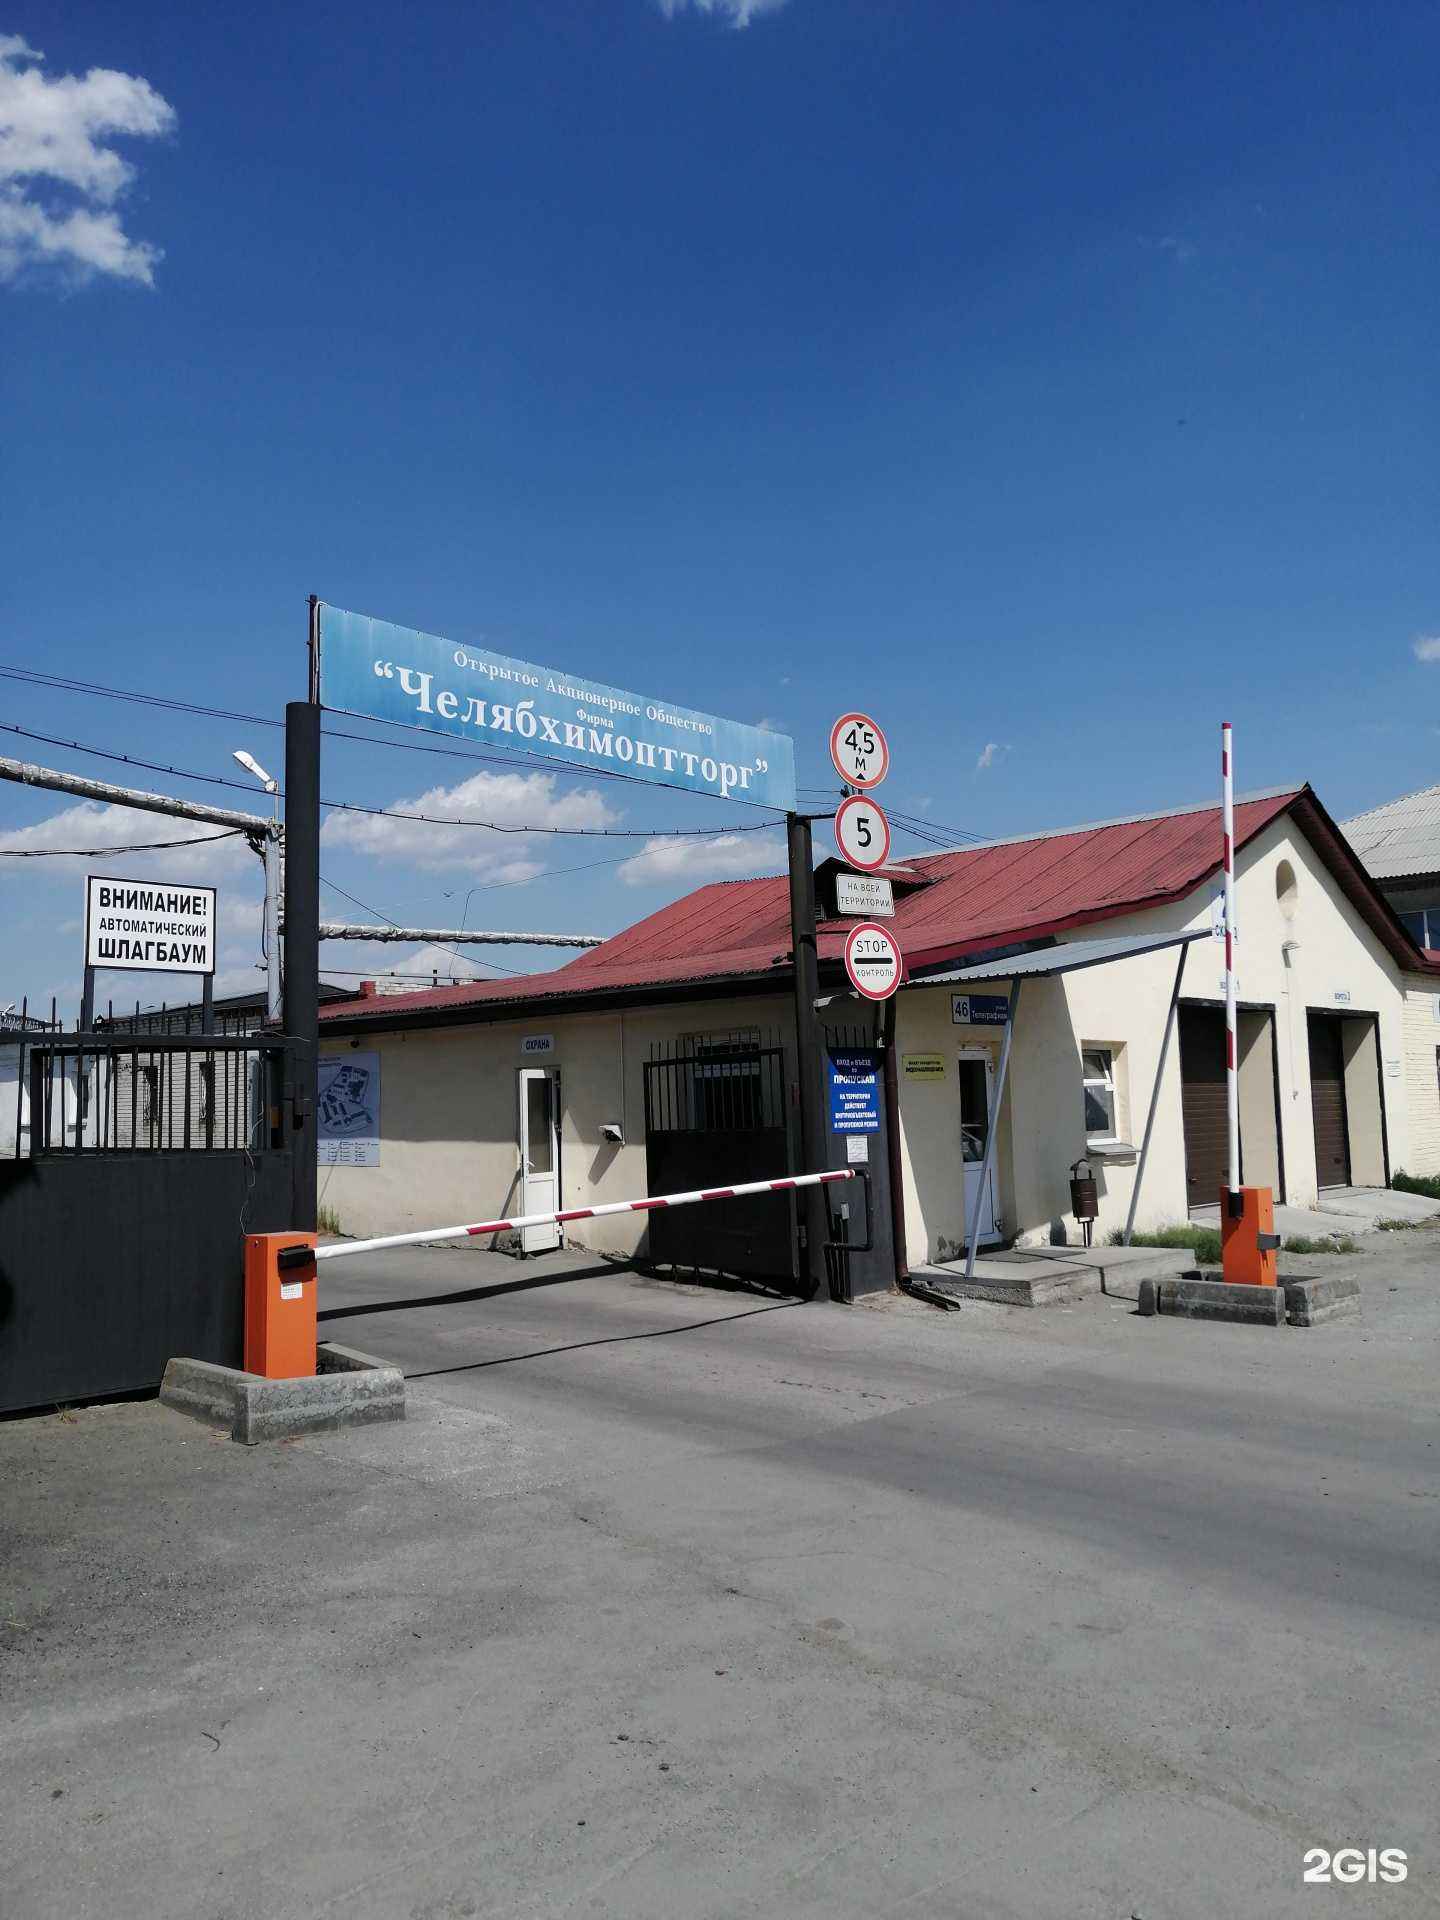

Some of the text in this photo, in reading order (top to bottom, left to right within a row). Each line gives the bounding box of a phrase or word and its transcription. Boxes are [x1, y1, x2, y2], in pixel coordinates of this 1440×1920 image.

[454, 650, 712, 736] Открытое Акционерное Общество
[576, 708, 615, 730] Фирма
[845, 729, 875, 755] 4,5
[857, 817, 872, 848] 5
[847, 882, 858, 892] НА
[99, 887, 207, 916] ВНИМАНИЕ!
[840, 896, 890, 908] ТЕРРИТОРИИ
[99, 917, 207, 938] АВТОМАТИЧЕСКИЙ
[98, 937, 206, 964] ШЛАГБАУМ
[856, 940, 888, 953] STOP
[856, 968, 894, 977] КОНТРОЛЬ
[954, 1001, 969, 1017] 46
[525, 1039, 550, 1050] ОХРАНА
[833, 1074, 876, 1084] ПРОПУСКАМ
